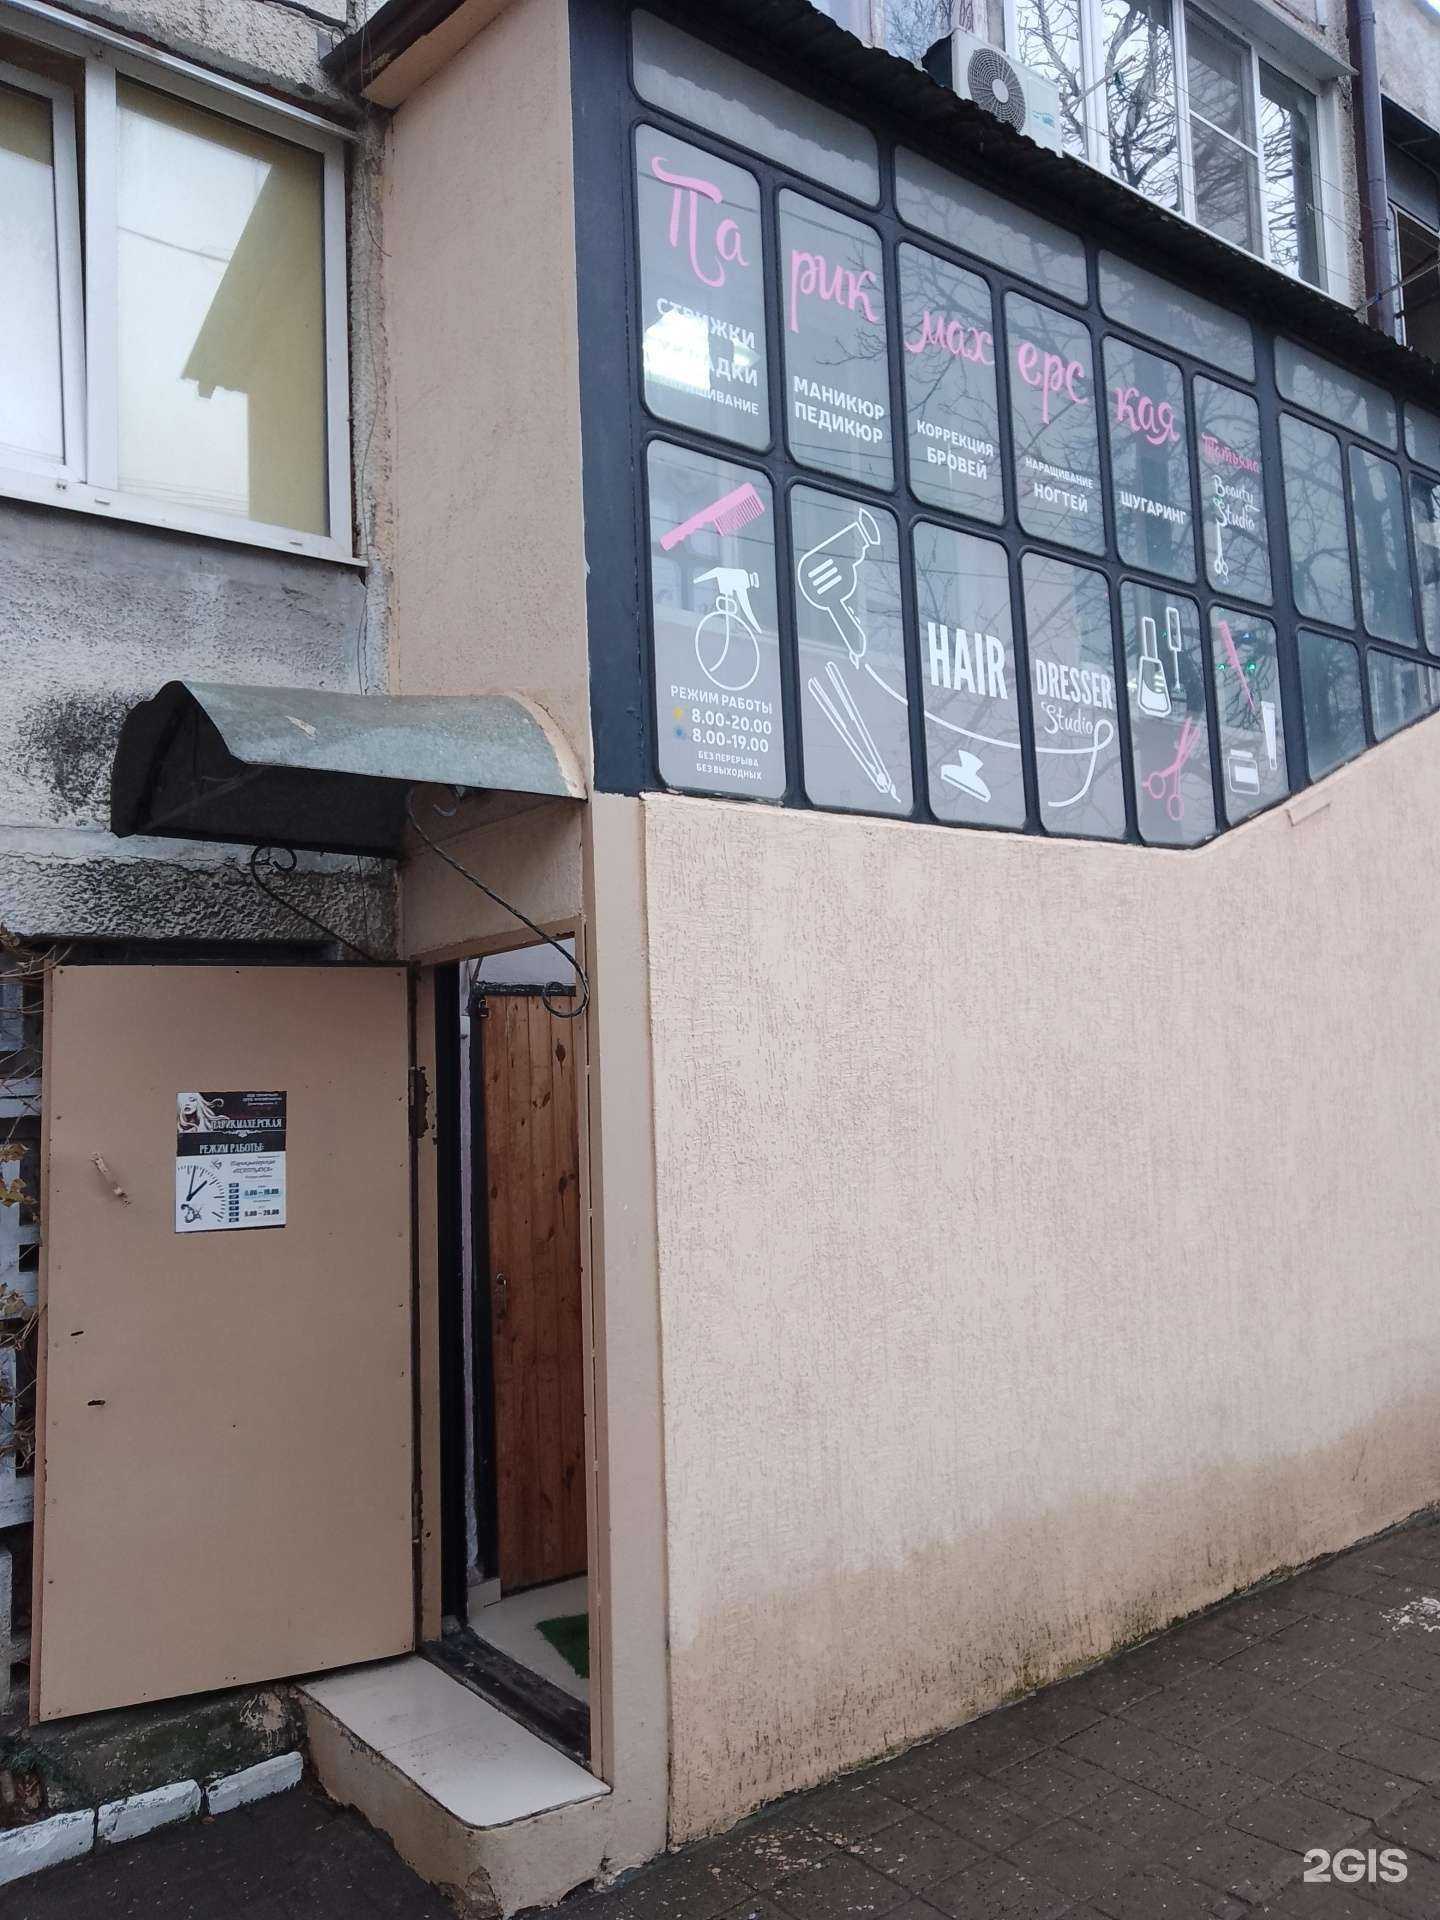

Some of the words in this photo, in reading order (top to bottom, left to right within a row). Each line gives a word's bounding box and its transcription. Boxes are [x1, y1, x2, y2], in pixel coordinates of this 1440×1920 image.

[651, 155, 749, 287] Па
[790, 249, 878, 334] рик
[904, 310, 996, 366] мах
[1017, 341, 1090, 425] ерс
[1113, 386, 1181, 445] кая
[793, 375, 885, 420] МАНИКЮР
[794, 401, 883, 444] ПЕДИКЮР
[916, 419, 994, 457] КОРРЕКЦИЯ
[926, 446, 988, 481] БРОВЕЙ
[1025, 456, 1095, 489] НАРАЩИВАНИЕ
[1033, 482, 1089, 513] НОГТЕЙ
[1119, 490, 1187, 525] ШУГАРИНГ
[1211, 474, 1261, 512] Beauty
[1212, 496, 1256, 530] Studio
[928, 621, 1008, 700] HAIR
[1035, 658, 1113, 710] DRESSER
[670, 685, 719, 705] РЕЖИМ
[721, 694, 773, 715] РАБОТЫ
[691, 707, 772, 735] 8.00-20.00
[1041, 701, 1094, 735] Studio
[692, 728, 769, 753] 8.00-19.00
[696, 763, 713, 774] БЕЗ
[714, 765, 762, 781] ВЫХОДНЫХ
[698, 750, 714, 761] БЕЗ
[715, 752, 759, 768] ПЕРЕРЫВА
[199, 1144, 229, 1155] РЕЖИМ
